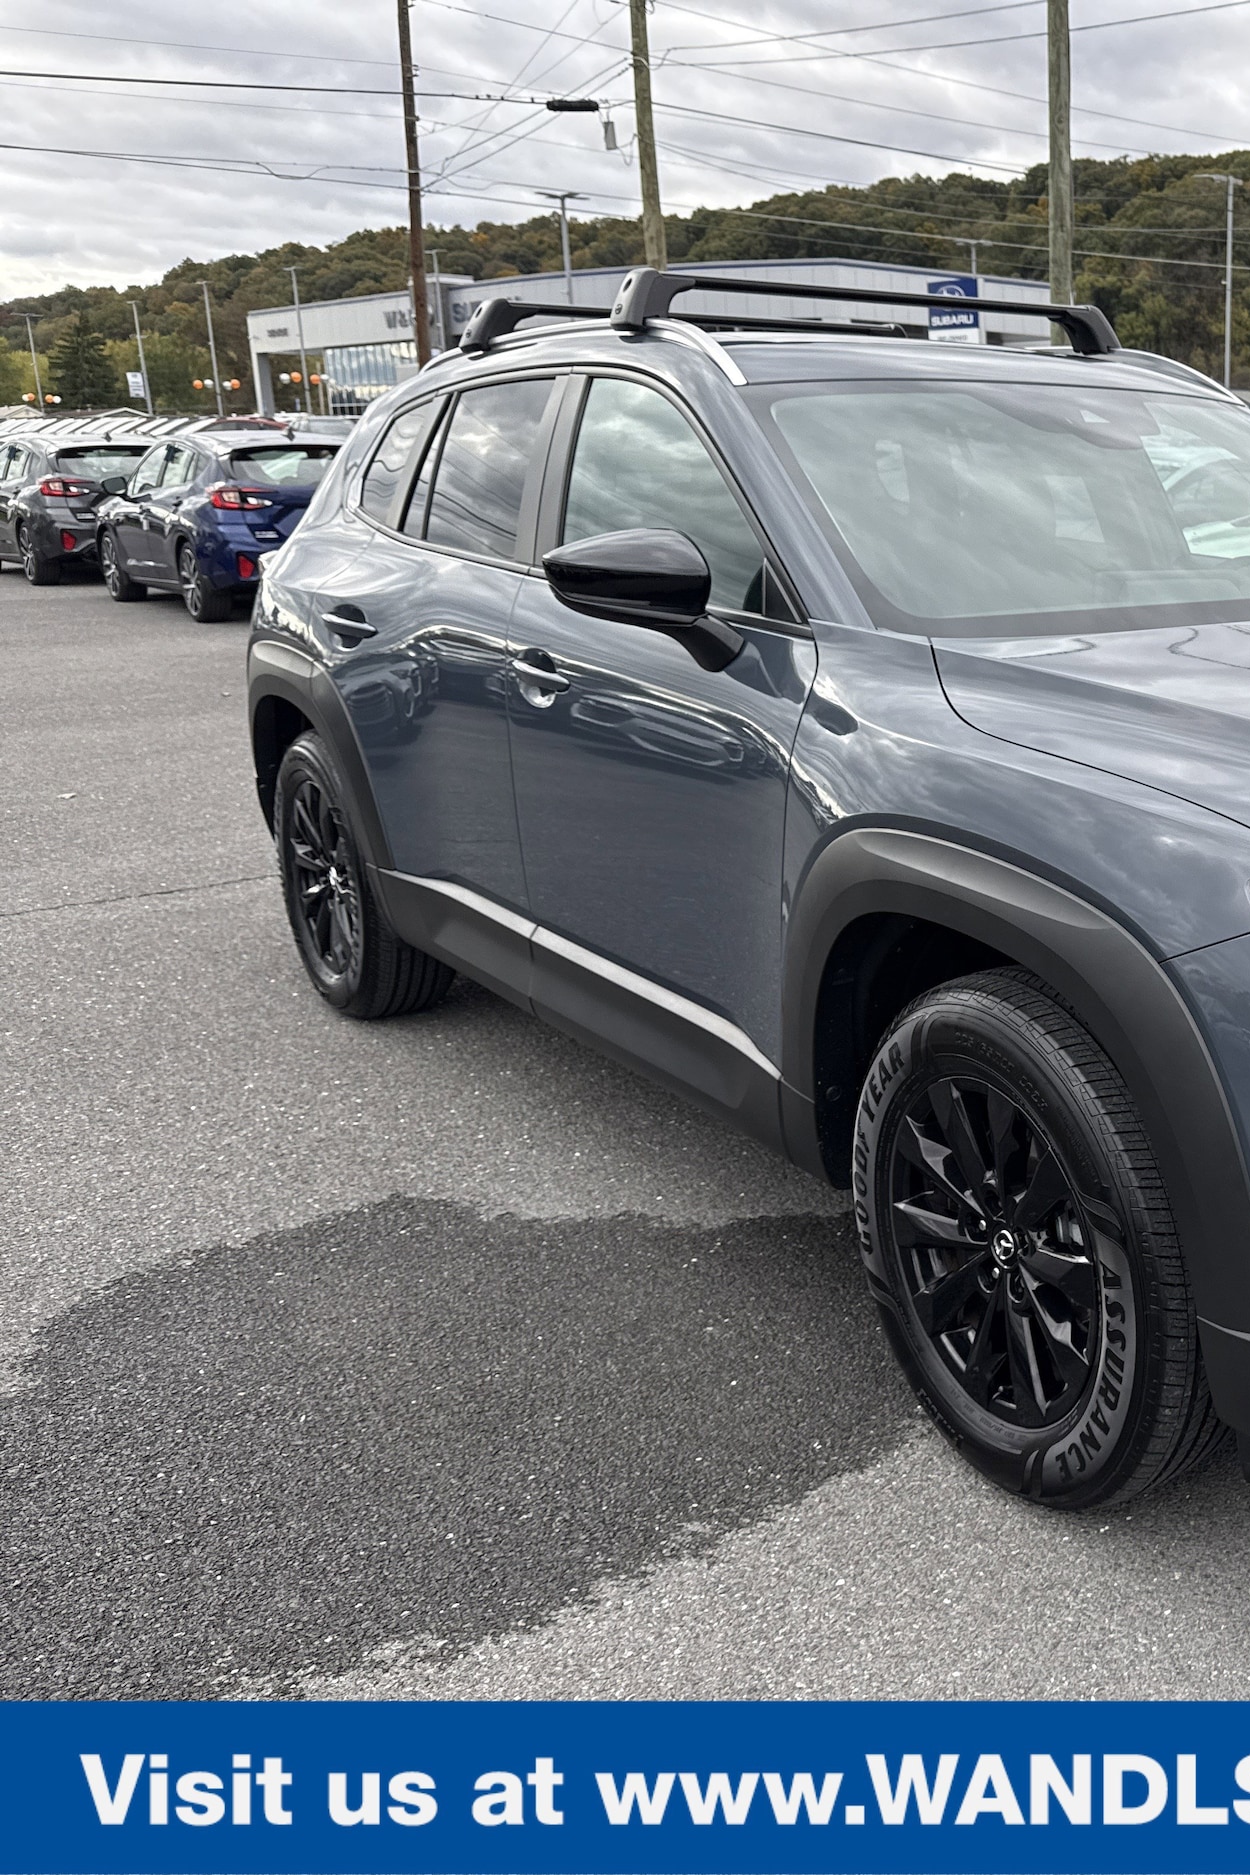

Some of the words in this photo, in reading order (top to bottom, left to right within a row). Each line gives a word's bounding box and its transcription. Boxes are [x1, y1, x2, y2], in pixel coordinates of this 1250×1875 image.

[931, 314, 974, 326] SUBARU
[852, 1041, 906, 1256] GOODYEAR
[1055, 1260, 1127, 1483] ASSURANCE
